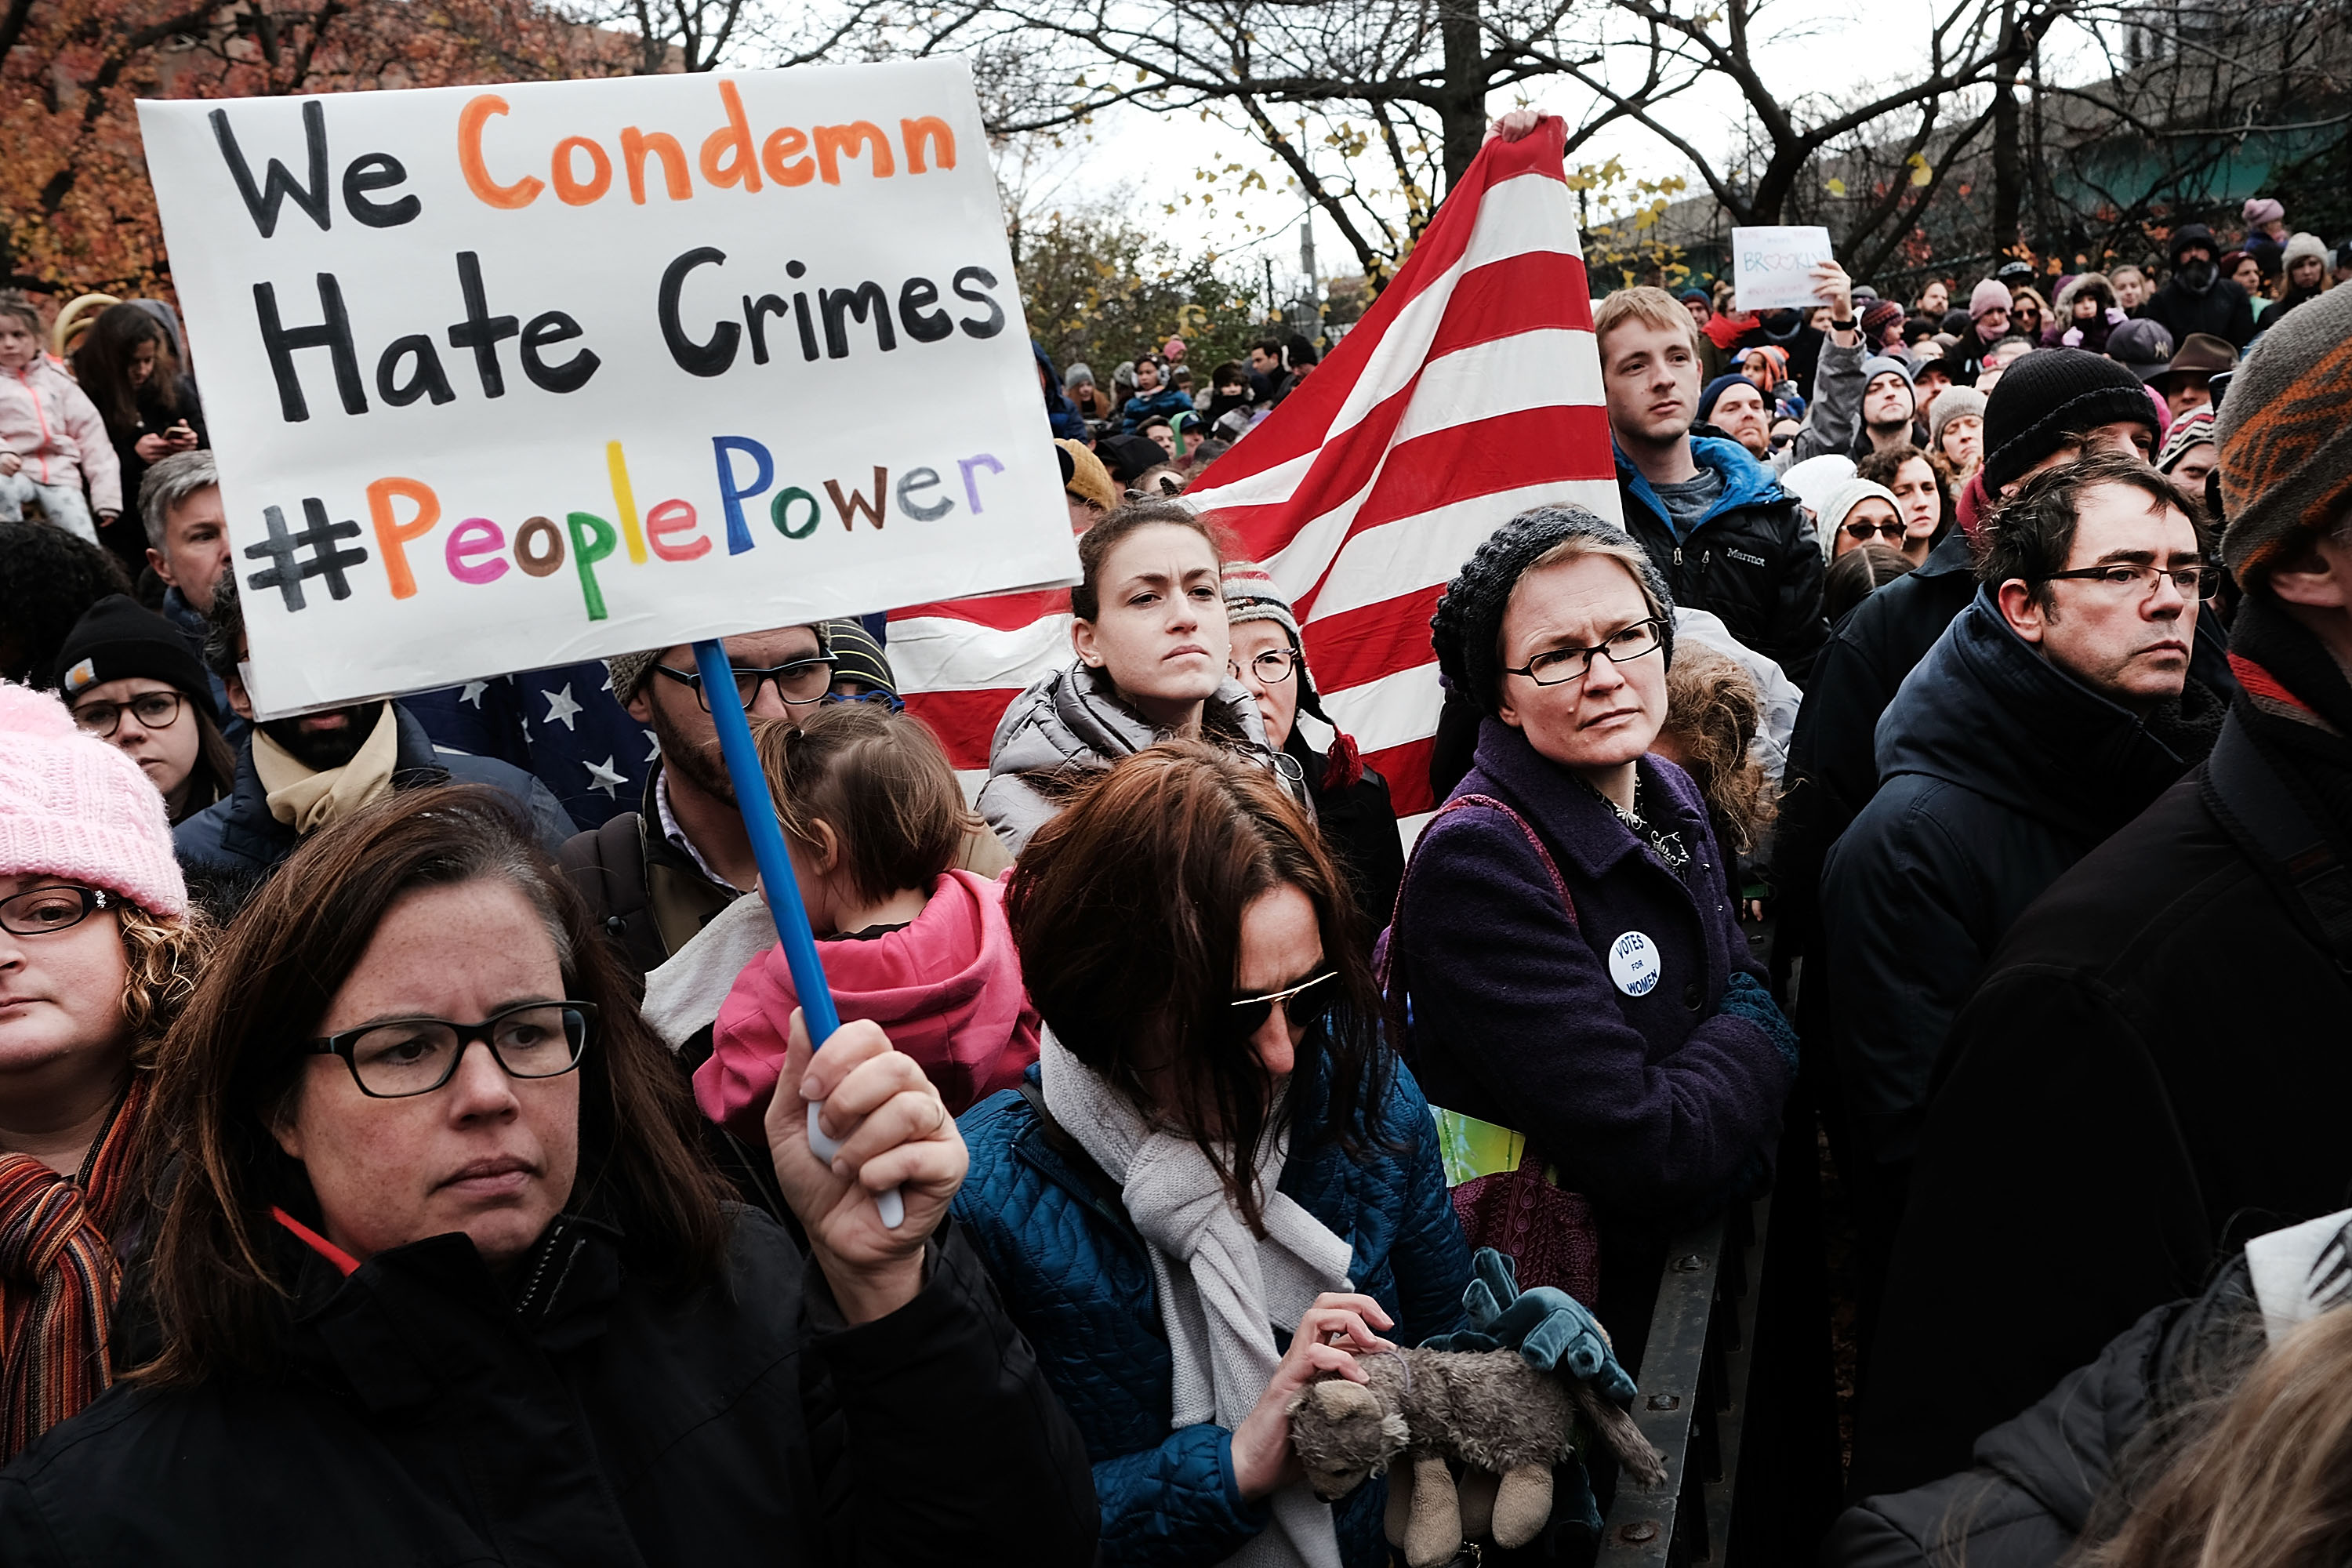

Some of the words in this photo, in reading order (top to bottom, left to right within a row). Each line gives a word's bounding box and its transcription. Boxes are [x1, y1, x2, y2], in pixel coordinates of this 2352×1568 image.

[209, 100, 422, 239] We
[457, 79, 956, 210] Condemn
[253, 251, 601, 423] Hate
[658, 246, 1006, 378] Crimes
[244, 435, 1006, 622] #PeoplePower
[1726, 547, 1766, 567] Marmot
[1616, 934, 1644, 959] VOTES
[1631, 960, 1644, 971] FOR
[1627, 969, 1657, 994] WOMEN
